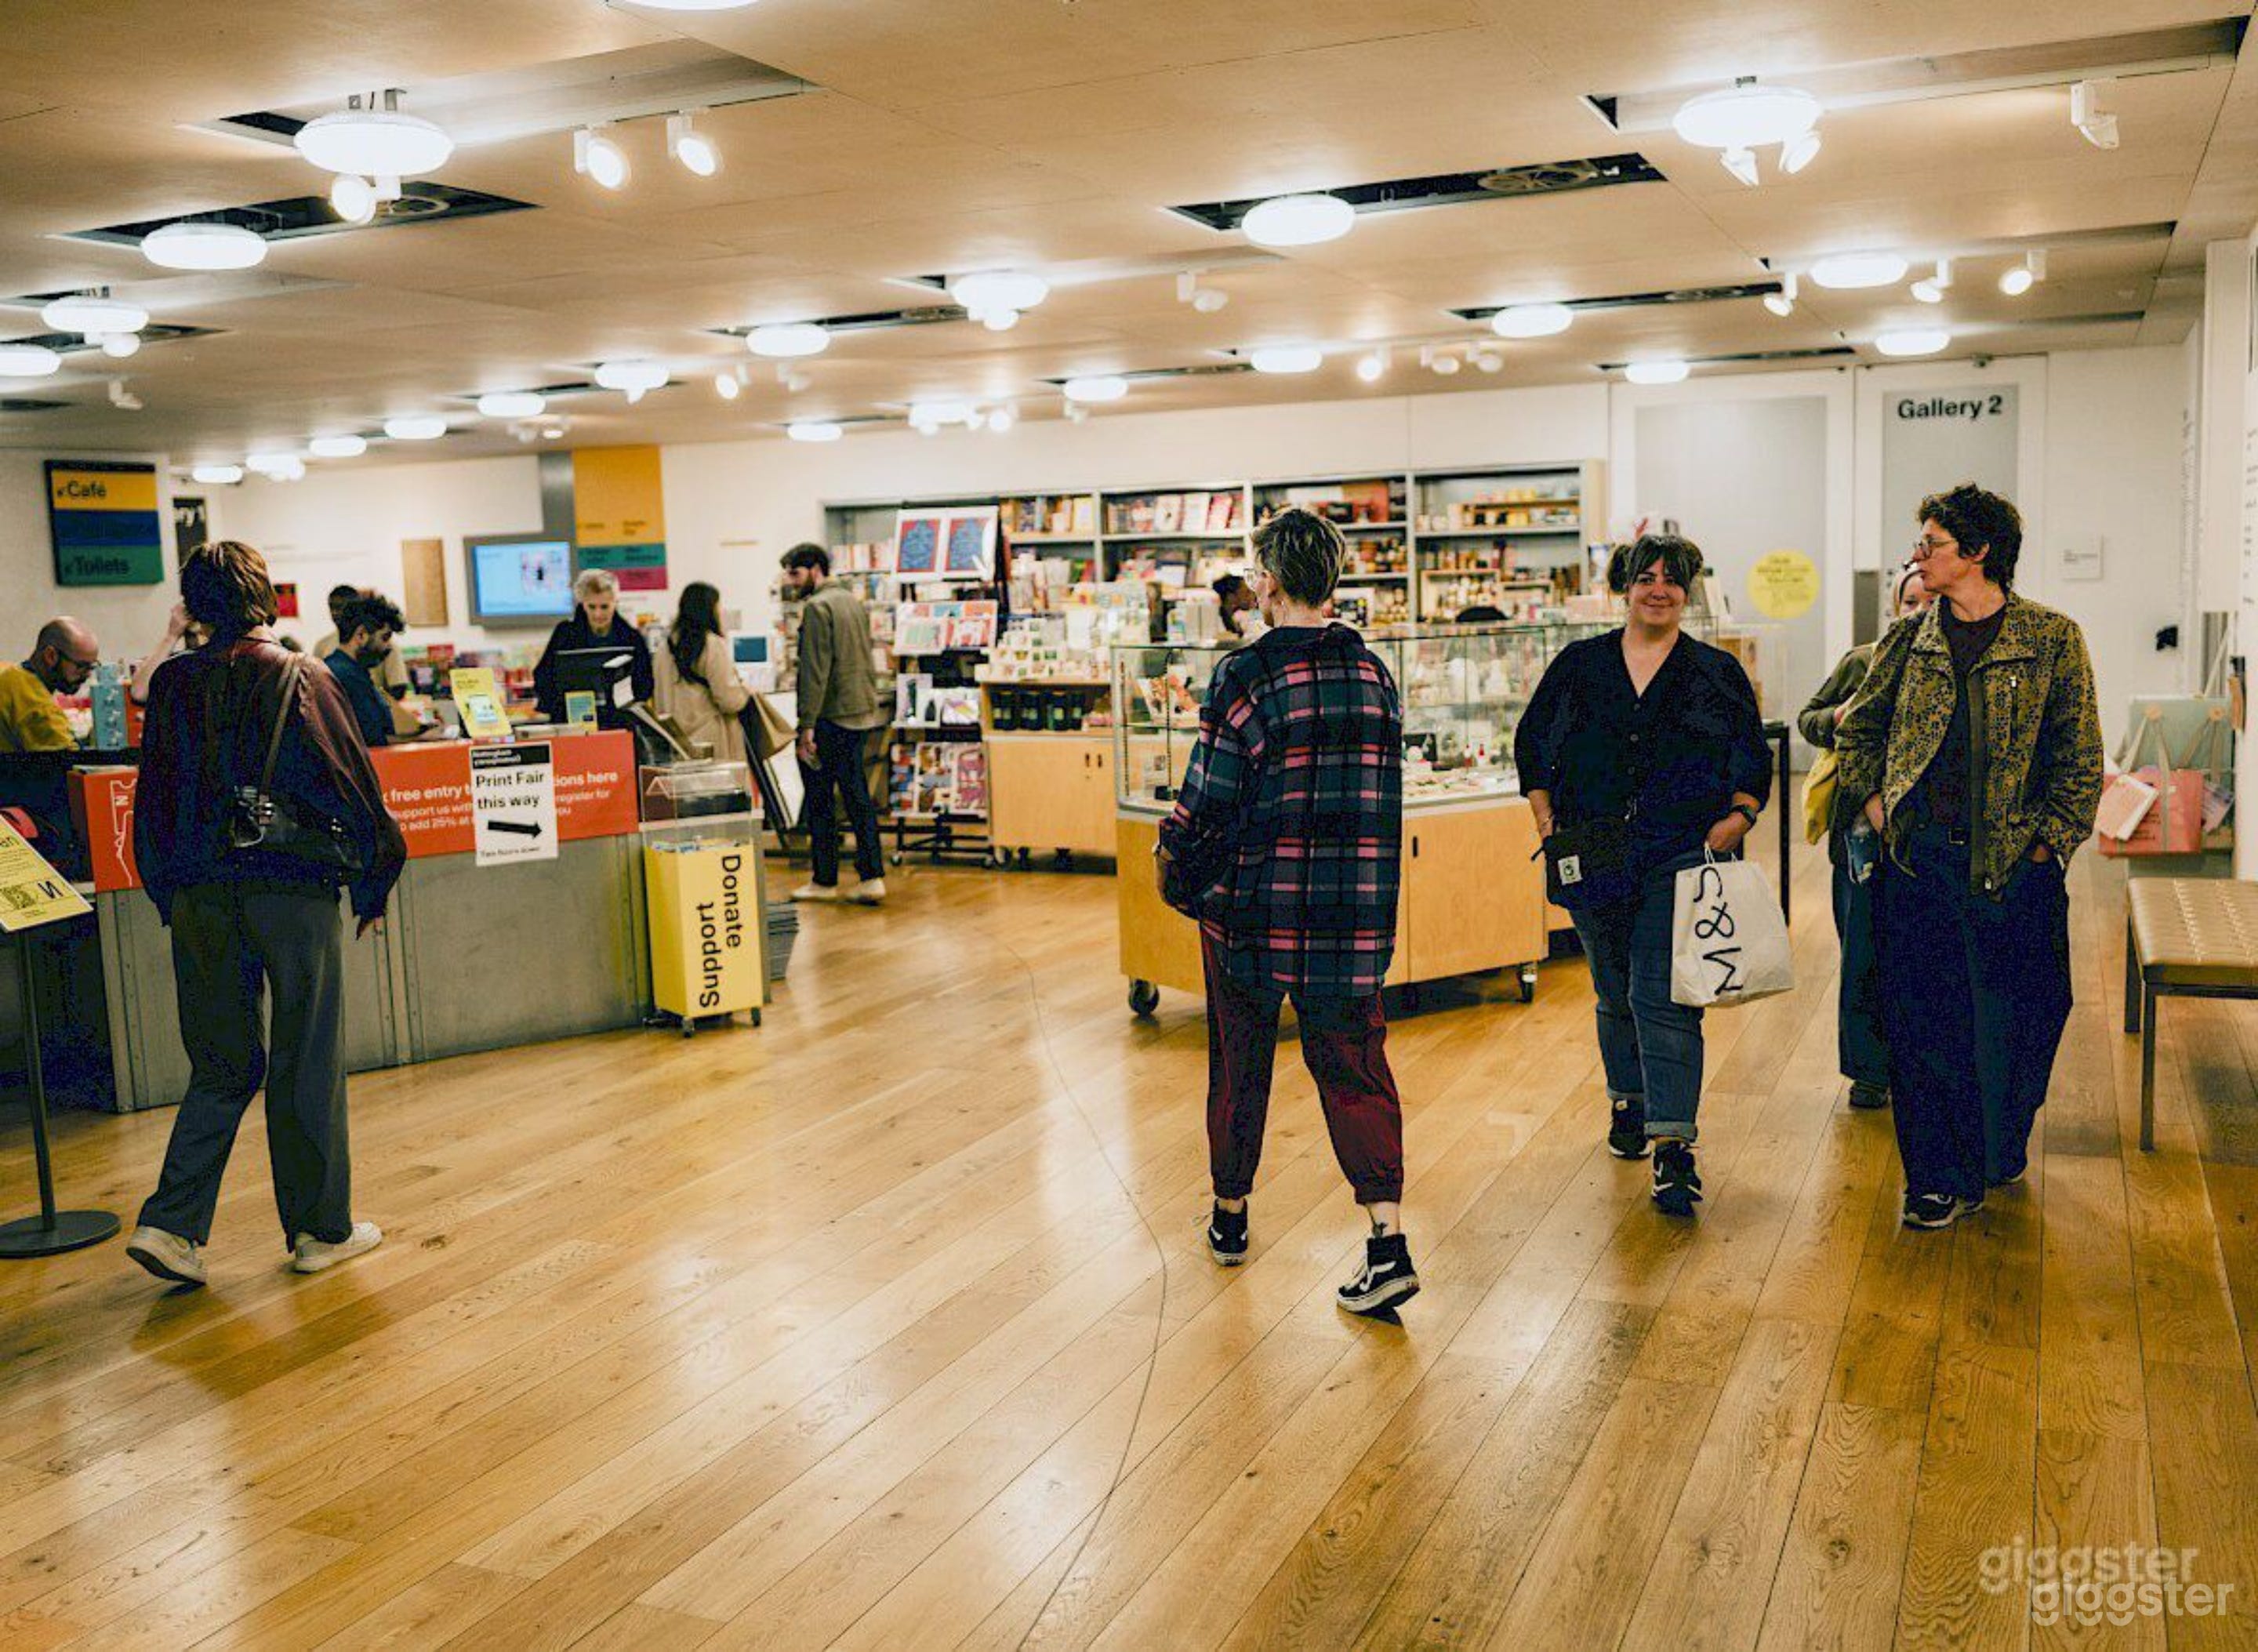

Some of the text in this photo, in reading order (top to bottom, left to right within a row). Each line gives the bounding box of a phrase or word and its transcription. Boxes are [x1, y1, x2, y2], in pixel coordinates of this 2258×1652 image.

[1897, 394, 2002, 420] Gallery 2
[74, 555, 130, 575] Toilets
[390, 788, 421, 804] free
[423, 784, 462, 801] entry
[554, 774, 583, 787] ions
[586, 771, 619, 785] here
[476, 770, 544, 788] Print Fair
[477, 794, 540, 809] this way
[722, 855, 742, 949] Donate
[1694, 866, 1744, 995] M&S
[696, 902, 723, 1008] Support
